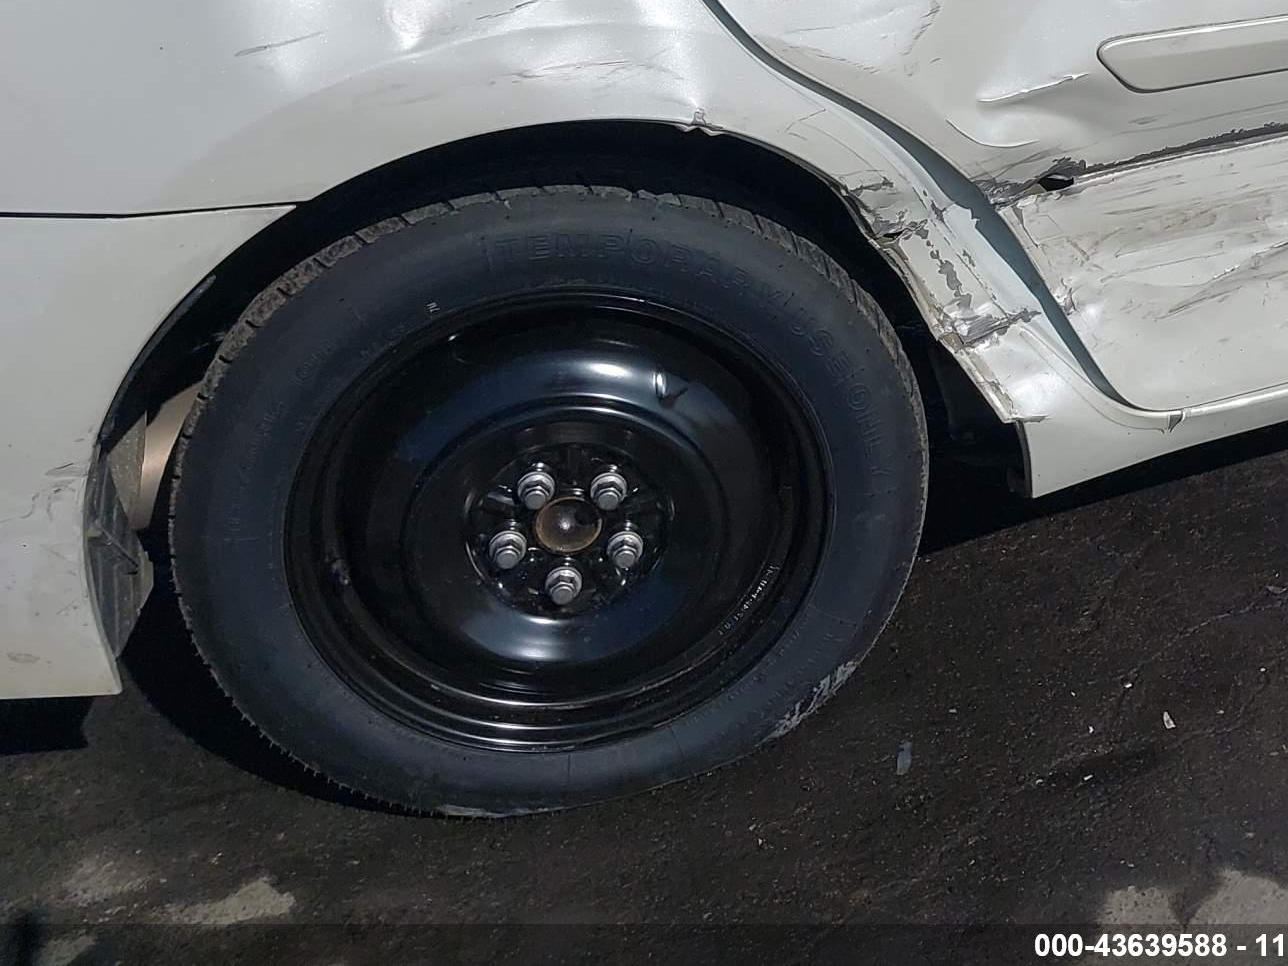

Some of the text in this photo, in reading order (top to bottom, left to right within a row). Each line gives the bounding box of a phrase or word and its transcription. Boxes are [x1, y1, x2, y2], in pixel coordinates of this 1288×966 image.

[494, 230, 895, 477] TEMPORARY USE ONLY
